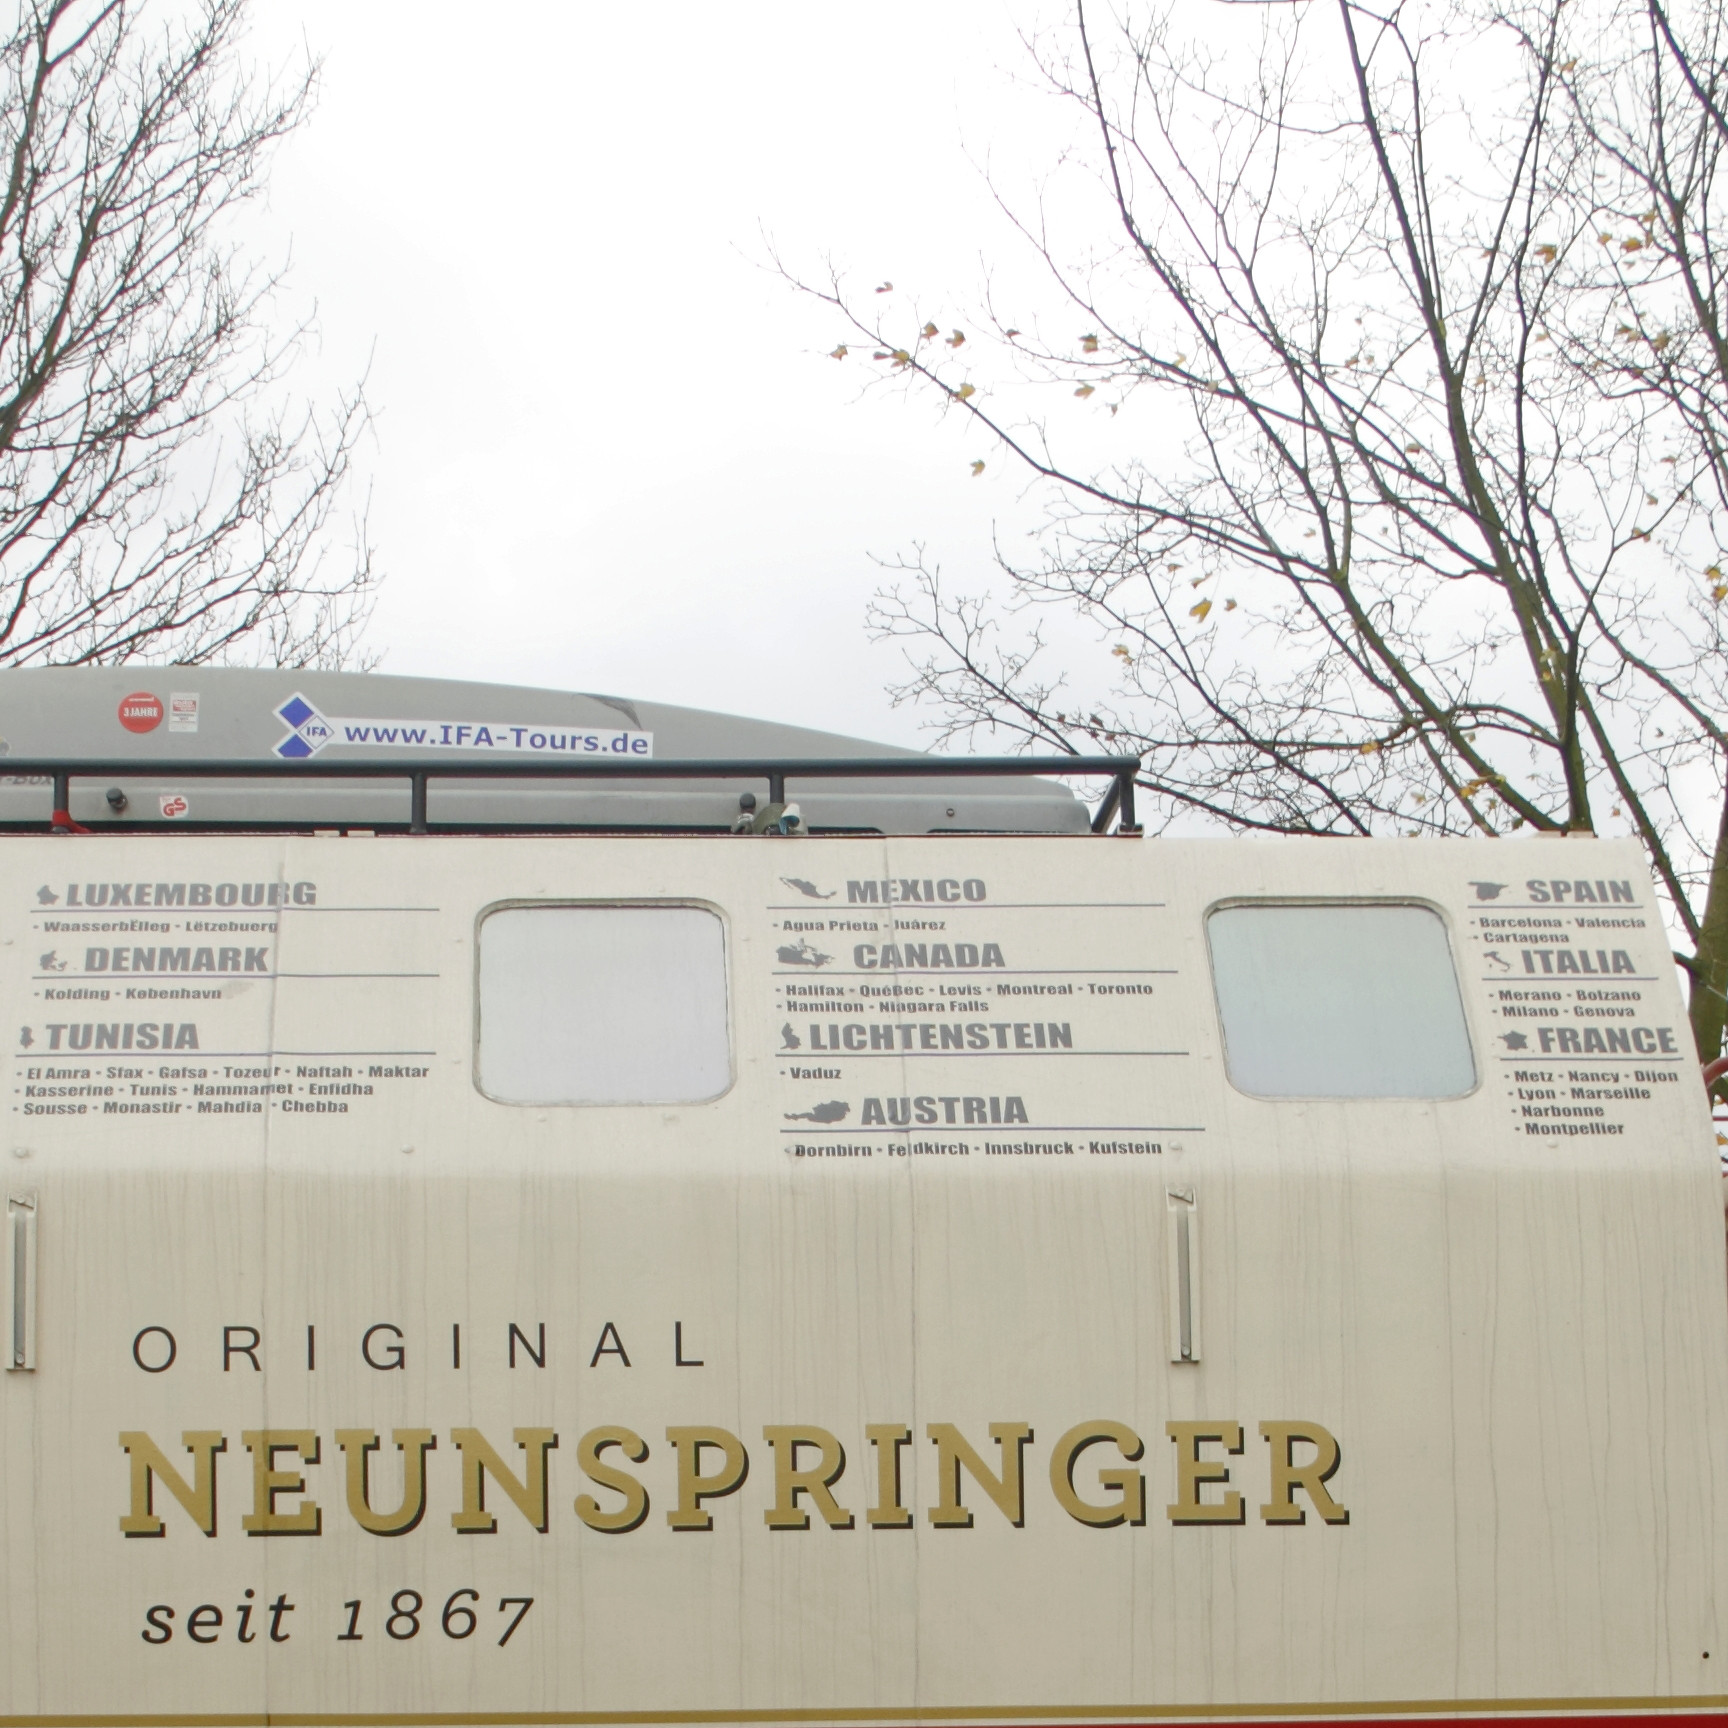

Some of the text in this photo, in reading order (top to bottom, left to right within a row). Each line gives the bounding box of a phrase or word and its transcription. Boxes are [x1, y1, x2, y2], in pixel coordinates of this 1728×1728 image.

[306, 726, 327, 737] IFA
[344, 725, 649, 755] www.IFA-Tours.de
[163, 797, 187, 817] GS
[66, 882, 317, 907] LUXEMBOURG
[846, 878, 987, 904] MEXICO
[1526, 879, 1635, 903] SPAIN
[782, 920, 825, 933] Agua
[828, 919, 879, 932] Prieta
[1479, 917, 1646, 928] Barcelona Valencia
[1483, 932, 1569, 944] Cartagena
[85, 946, 270, 972] DENMARK
[853, 942, 1006, 969] CANADA
[1521, 949, 1636, 974] ITALIA
[44, 988, 111, 1001] Kolding
[786, 984, 845, 997] Halifax
[939, 984, 982, 996] Levis
[996, 983, 1073, 996] Montreal
[1086, 983, 1153, 995] Toronto
[1498, 990, 1641, 1001] Merano Bolzano
[786, 1000, 990, 1014] Hamilton Niagara Falls
[1502, 1006, 1635, 1017] Milano Genova
[45, 1023, 200, 1050] TUNISIA
[809, 1022, 1072, 1050] LICHTENSTEIN
[1537, 1027, 1678, 1054] FRANCE
[27, 1065, 430, 1080] El Amra Sfax Gafsa Tozeur Naftah Maktar
[790, 1067, 842, 1080] Vaduz
[1514, 1070, 1678, 1084] Metz Nancy Dijon
[25, 1084, 114, 1098] Kasserine
[130, 1084, 178, 1097] Tunis
[309, 1082, 374, 1096] Enfidha
[1518, 1087, 1651, 1101] Lyon Marseille
[23, 1099, 349, 1116] Sousse Monastir Mahdia Chebba
[860, 1096, 1029, 1126] AUSTRIA
[1521, 1105, 1604, 1117] Narbonne
[1525, 1123, 1624, 1136] Montpellier
[795, 1144, 872, 1157] Dornbirn
[985, 1141, 1074, 1156] Innsbruck
[1089, 1141, 1162, 1155] Kufstein
[132, 1321, 705, 1373] ORIGINAL
[119, 1419, 1349, 1537] NEUNSPRINGER
[142, 1590, 536, 1650] seit 1867
